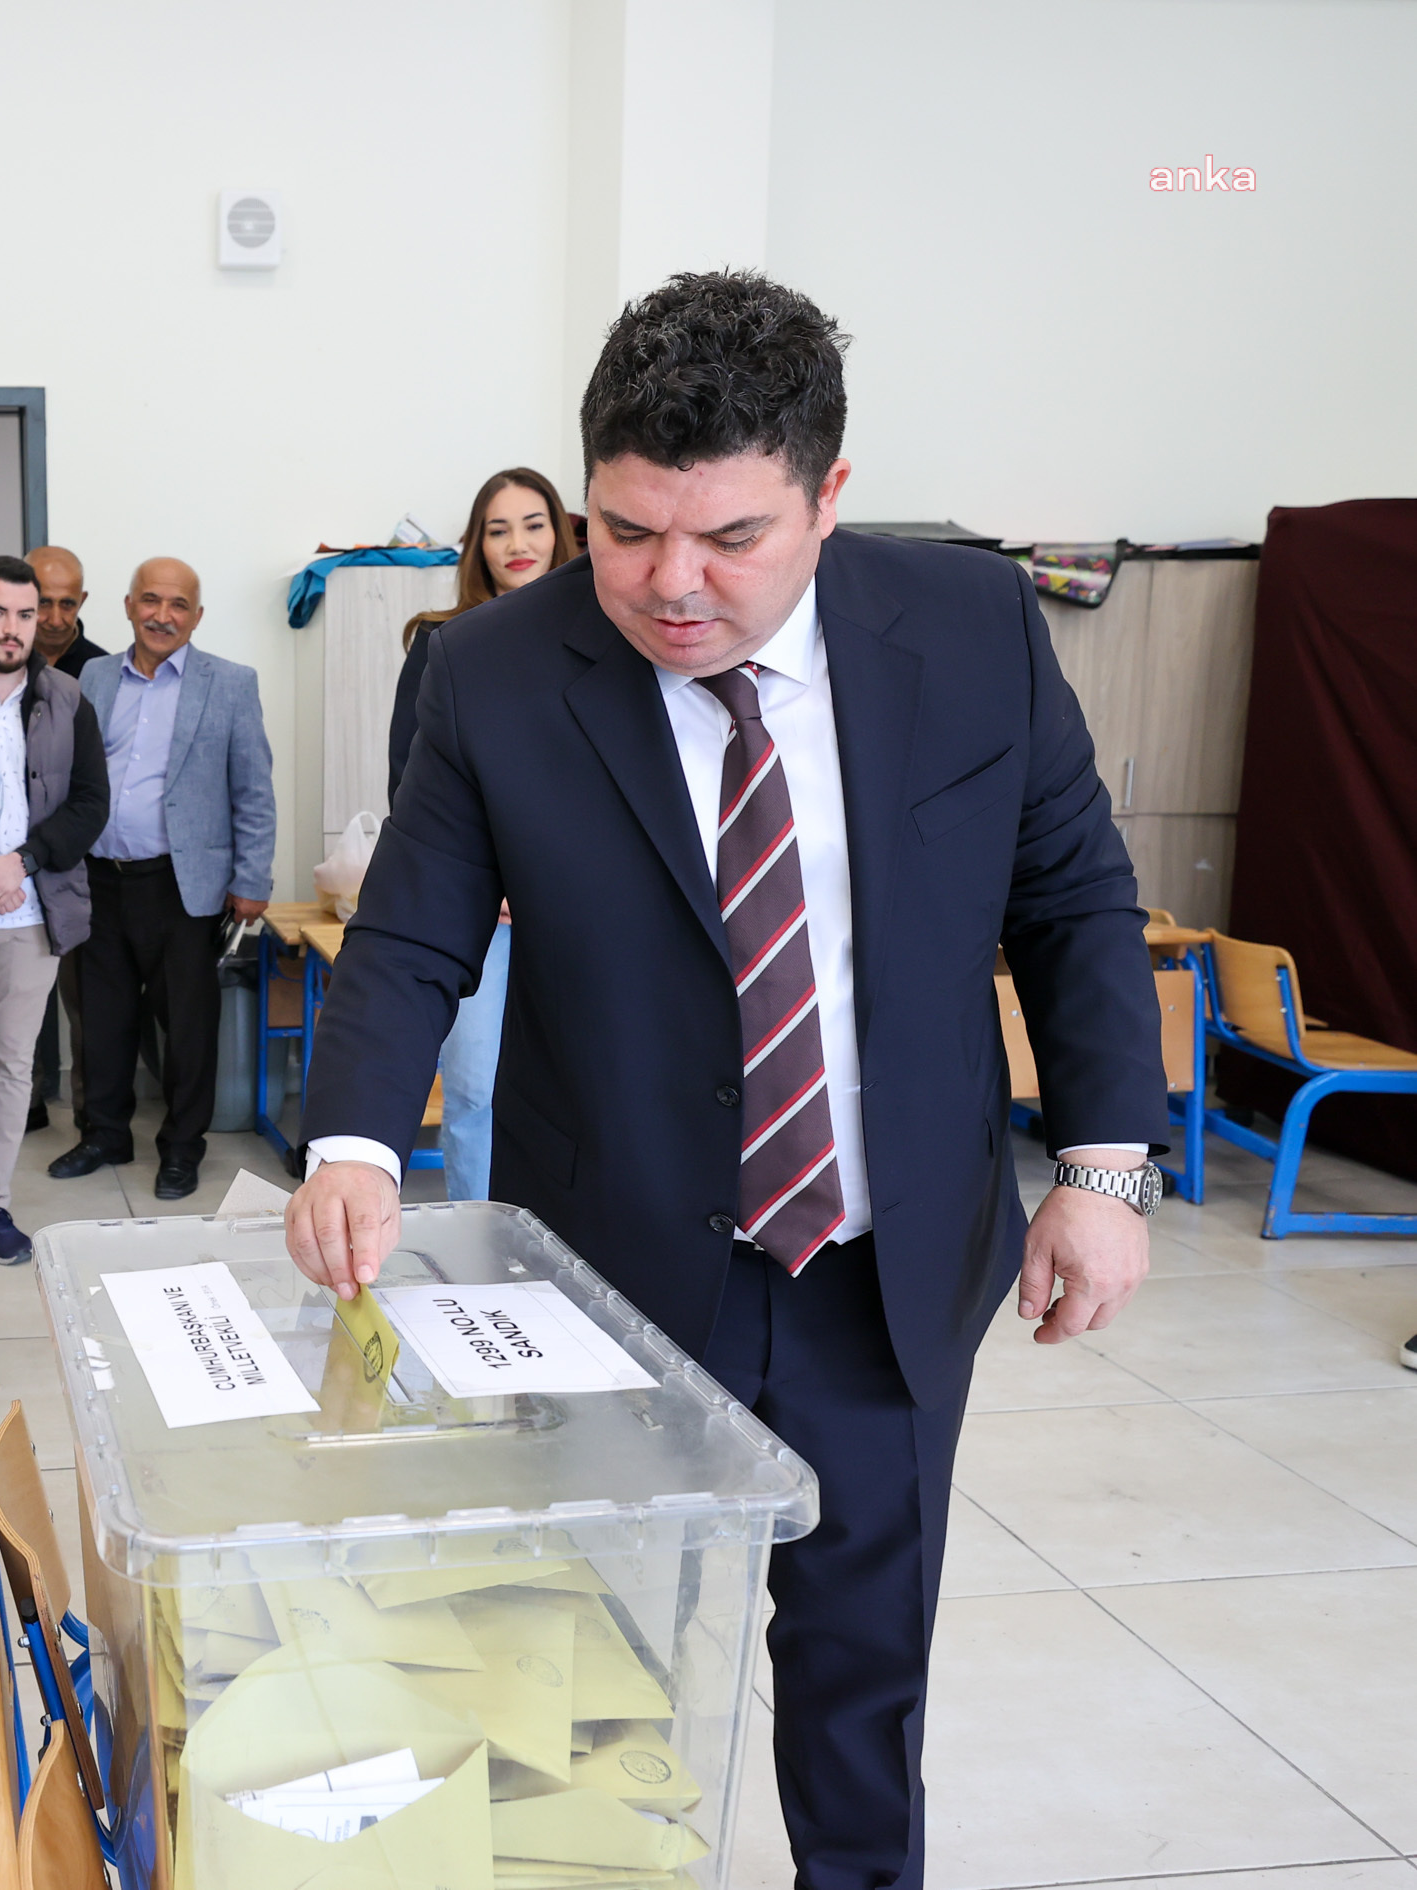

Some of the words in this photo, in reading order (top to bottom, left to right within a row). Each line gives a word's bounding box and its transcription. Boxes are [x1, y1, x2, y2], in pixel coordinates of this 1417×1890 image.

[163, 1285, 185, 1301] VE
[432, 1298, 485, 1336] NO.LU
[479, 1309, 544, 1359] SANDIK
[170, 1300, 236, 1391] CUMHURBAŞKANI
[204, 1316, 267, 1386] MİLLETVEKİLİ
[469, 1338, 512, 1369] 1299
